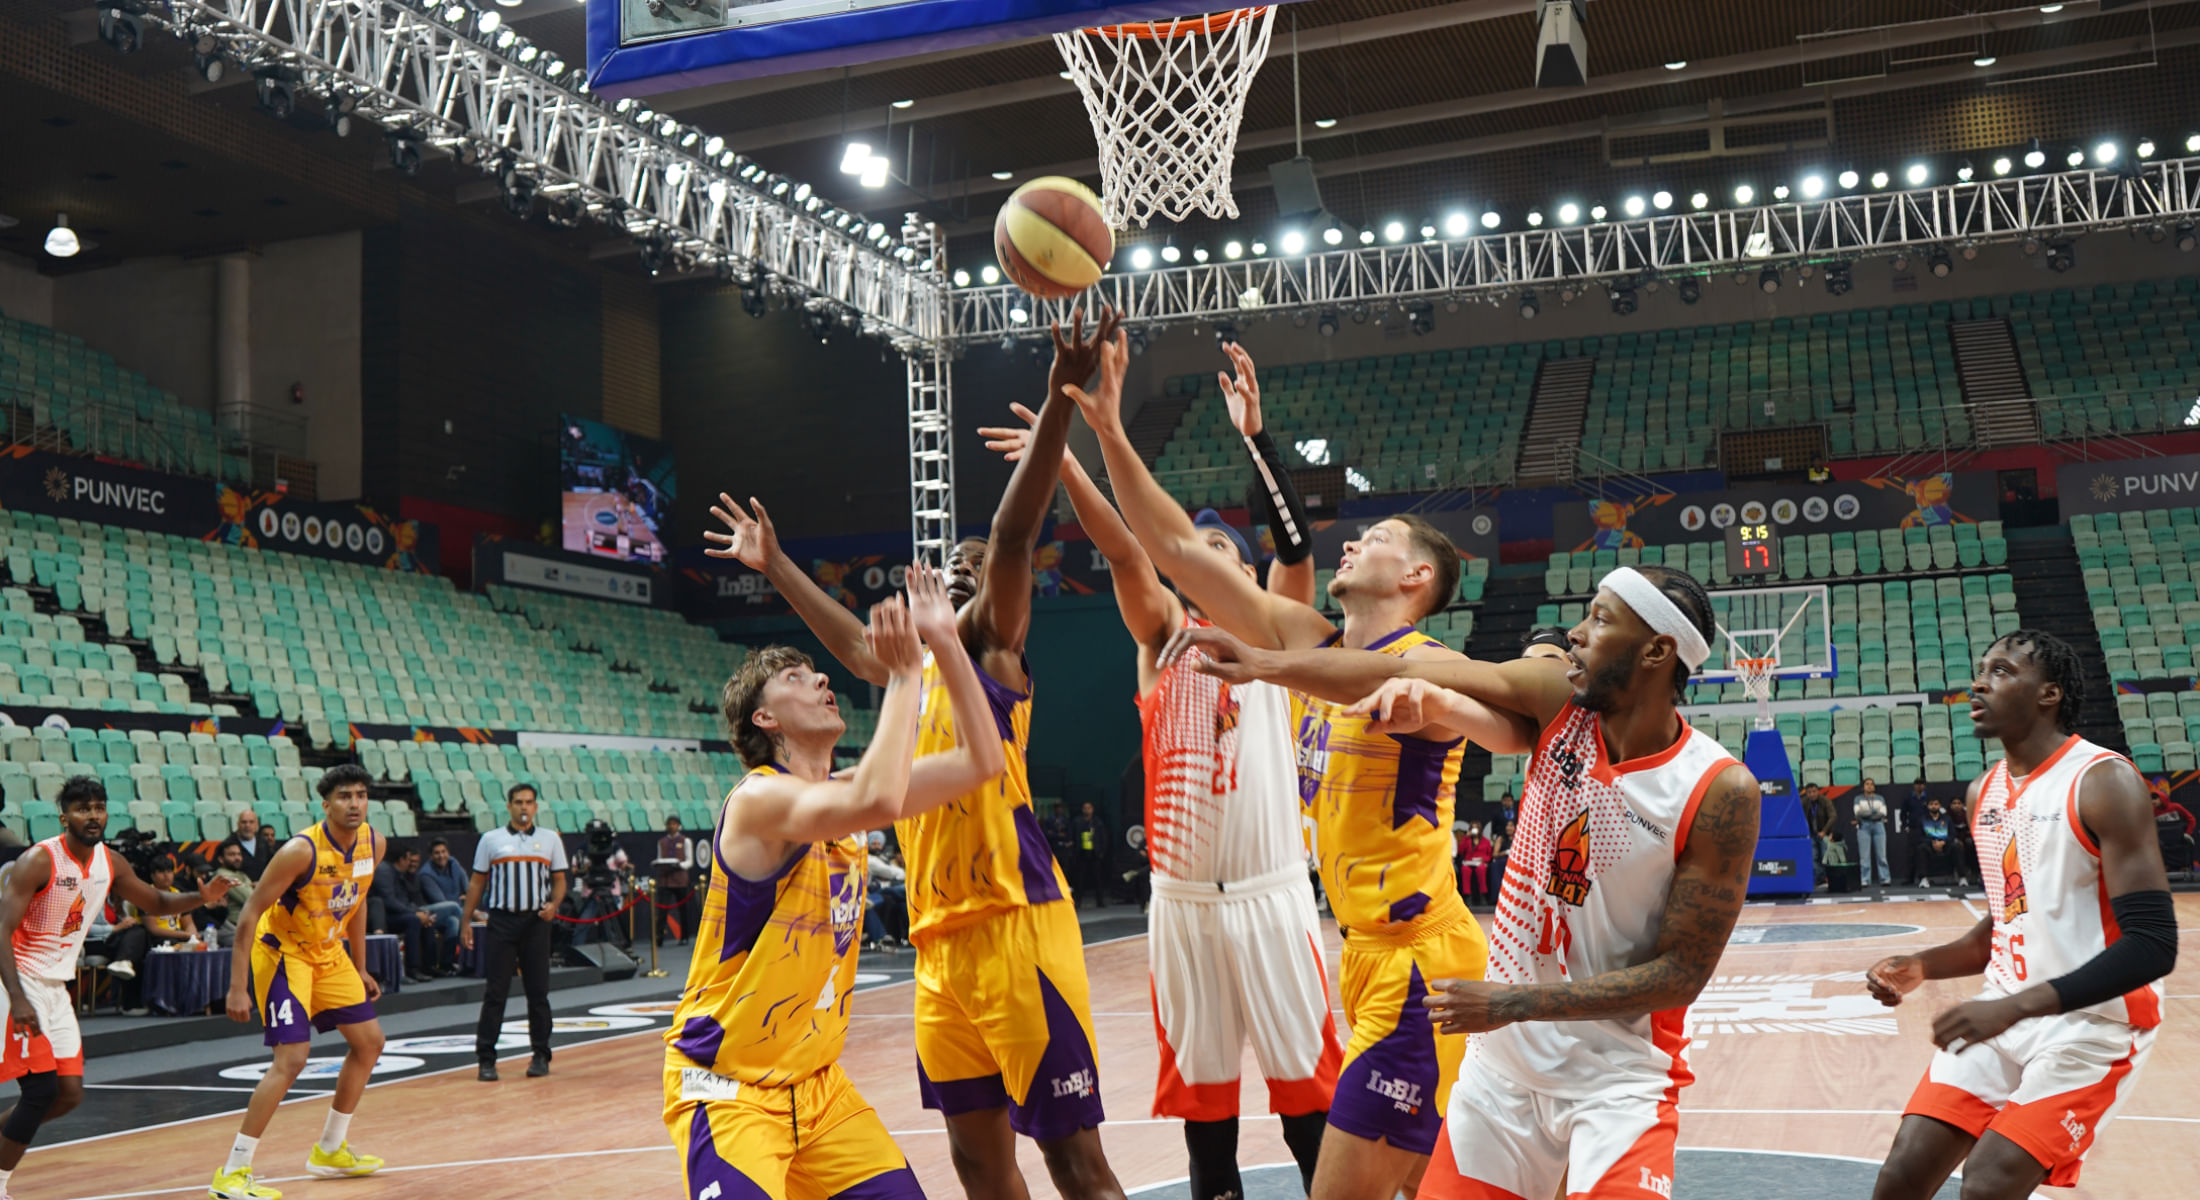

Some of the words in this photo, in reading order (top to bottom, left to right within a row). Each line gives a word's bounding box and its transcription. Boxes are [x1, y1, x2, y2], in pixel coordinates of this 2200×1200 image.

[74, 476, 165, 514] PUNVEC
[1740, 525, 1769, 540] 9:15
[1744, 545, 1769, 569] 17
[717, 573, 777, 597] InBL
[1211, 749, 1238, 795] 21
[1625, 810, 1667, 839] PUNVEC
[2010, 934, 2028, 981] 6
[269, 998, 294, 1028] 14
[13, 1031, 30, 1058] 7
[684, 1069, 735, 1088] HYATT
[1051, 1067, 1093, 1098] InBL
[1366, 1069, 1422, 1107] InBL
